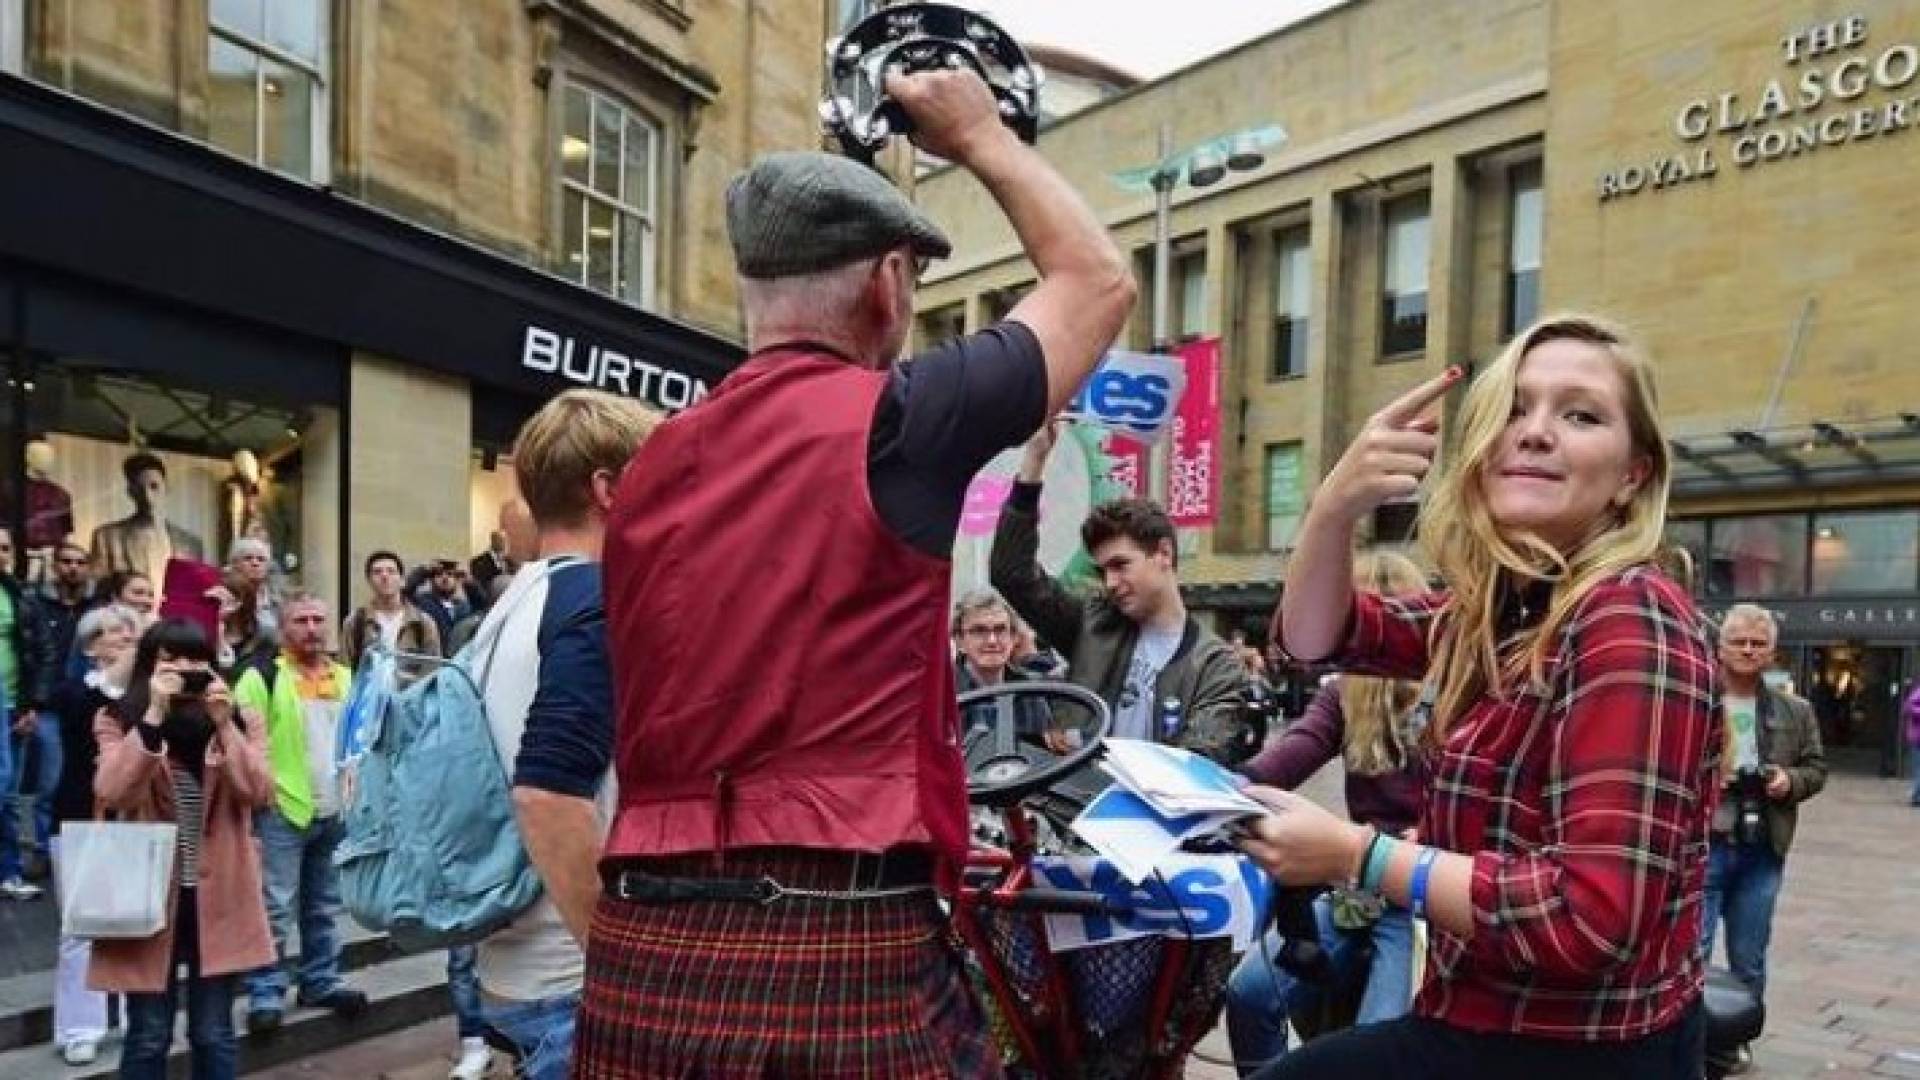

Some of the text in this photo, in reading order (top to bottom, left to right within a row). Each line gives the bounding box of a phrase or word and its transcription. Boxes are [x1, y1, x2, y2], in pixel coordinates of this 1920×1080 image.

[1783, 14, 1867, 62] THE
[1677, 45, 1919, 139] GLASGO
[1600, 148, 1717, 199] ROYAL
[1067, 369, 1169, 420] es
